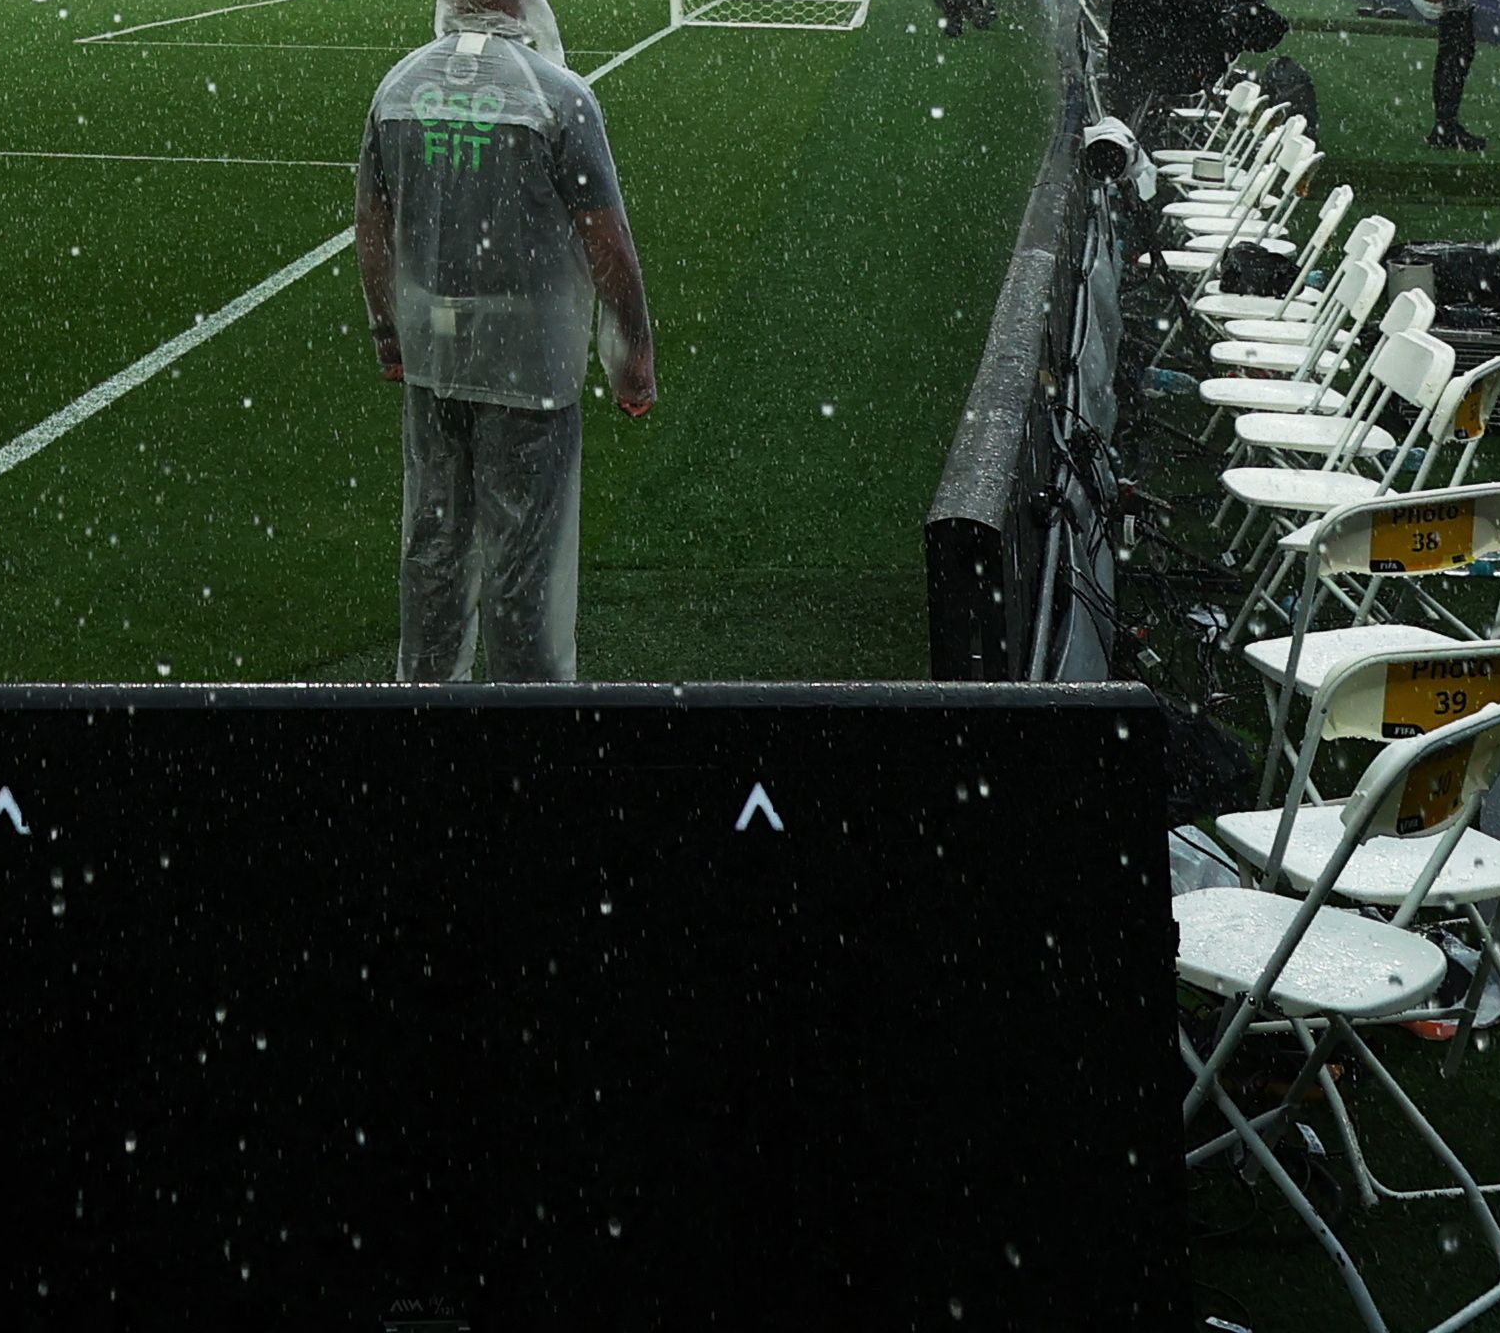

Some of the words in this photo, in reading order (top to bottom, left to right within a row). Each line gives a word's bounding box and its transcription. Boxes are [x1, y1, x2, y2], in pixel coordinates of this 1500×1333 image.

[424, 132, 491, 173] FIT
[1411, 531, 1440, 552] 38
[1380, 562, 1398, 570] FIFA
[1434, 690, 1468, 715] 39
[1394, 726, 1416, 736] FIFA
